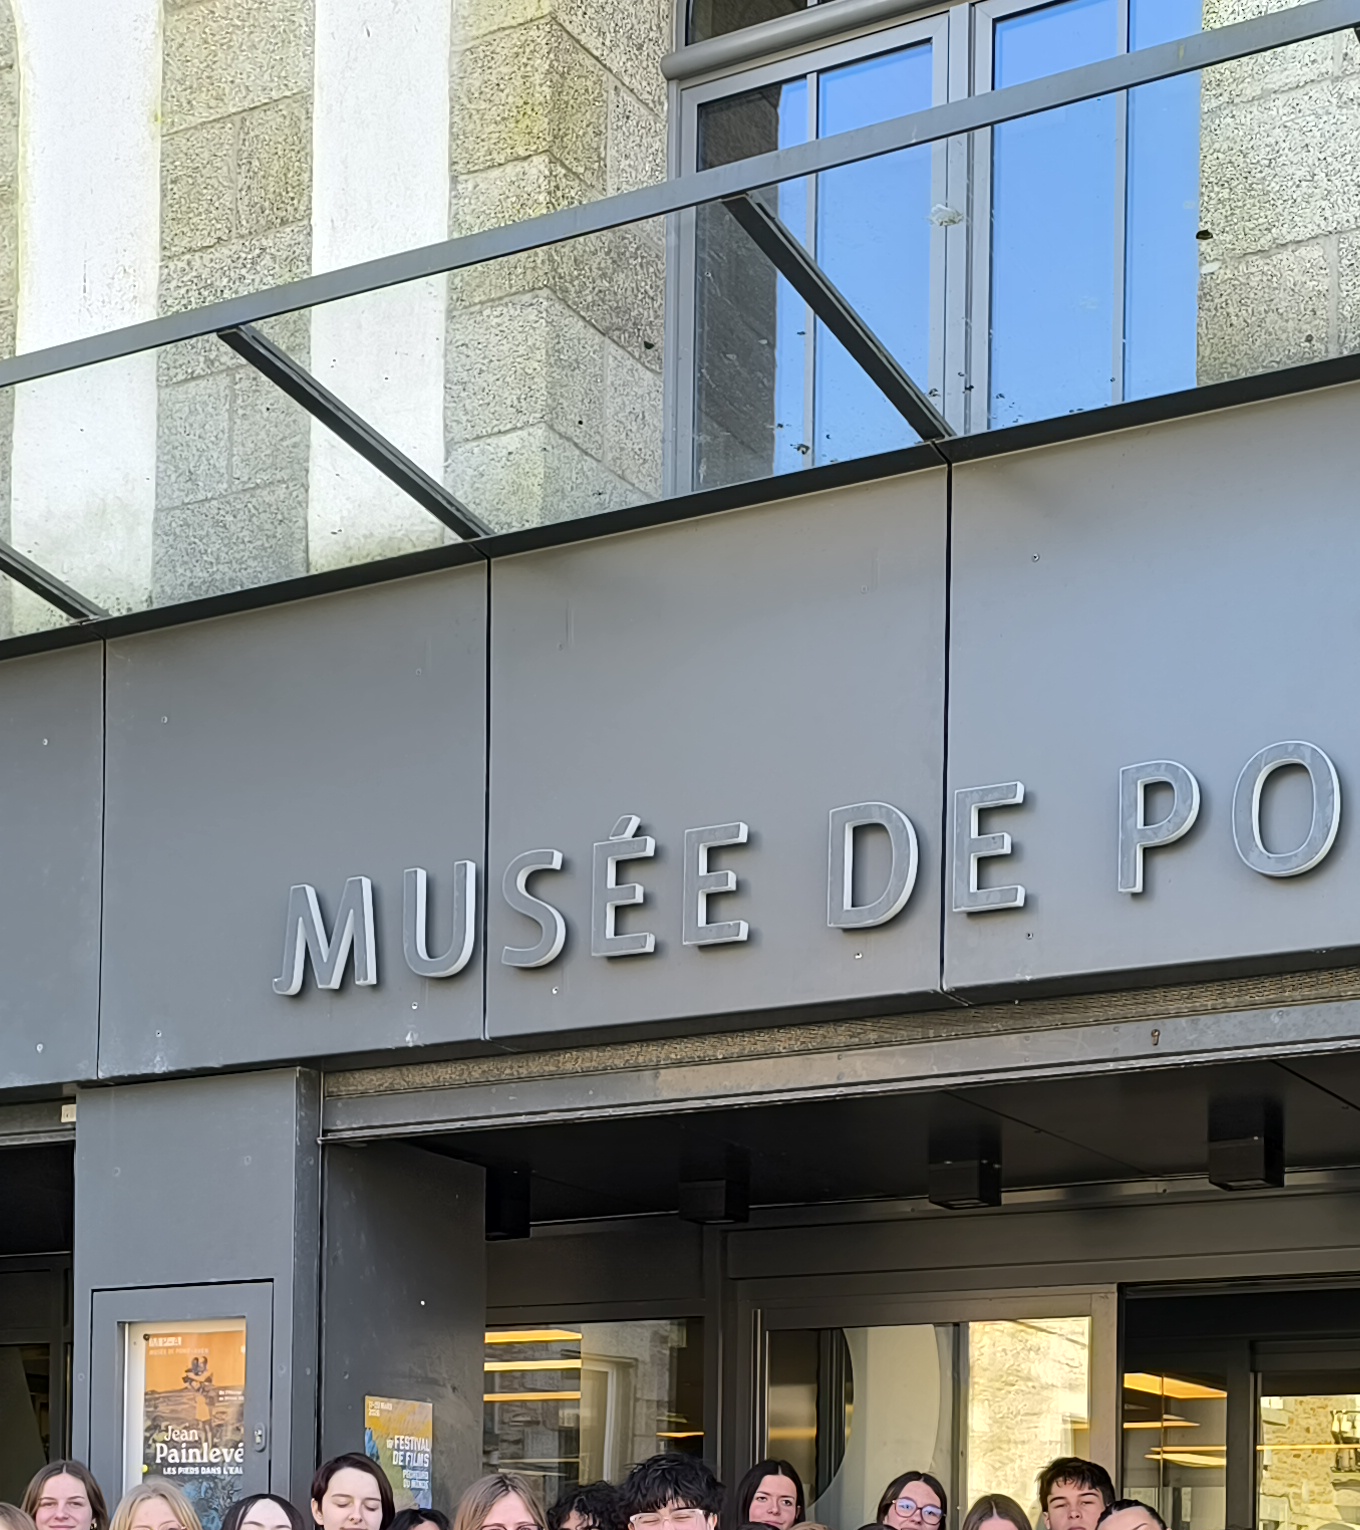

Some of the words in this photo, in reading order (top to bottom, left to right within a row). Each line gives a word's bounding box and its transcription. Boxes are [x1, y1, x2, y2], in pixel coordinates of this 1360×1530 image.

[272, 813, 749, 996] MUSÉE
[827, 780, 1026, 931] DE
[164, 1425, 199, 1441] Jean
[394, 1434, 430, 1452] FESTIVAL
[155, 1442, 244, 1464] Painlevé
[392, 1450, 405, 1466] DE
[405, 1452, 430, 1468] FILMS
[162, 1466, 177, 1475] LES
[178, 1466, 200, 1475] PIEDS
[200, 1466, 222, 1475] DANS
